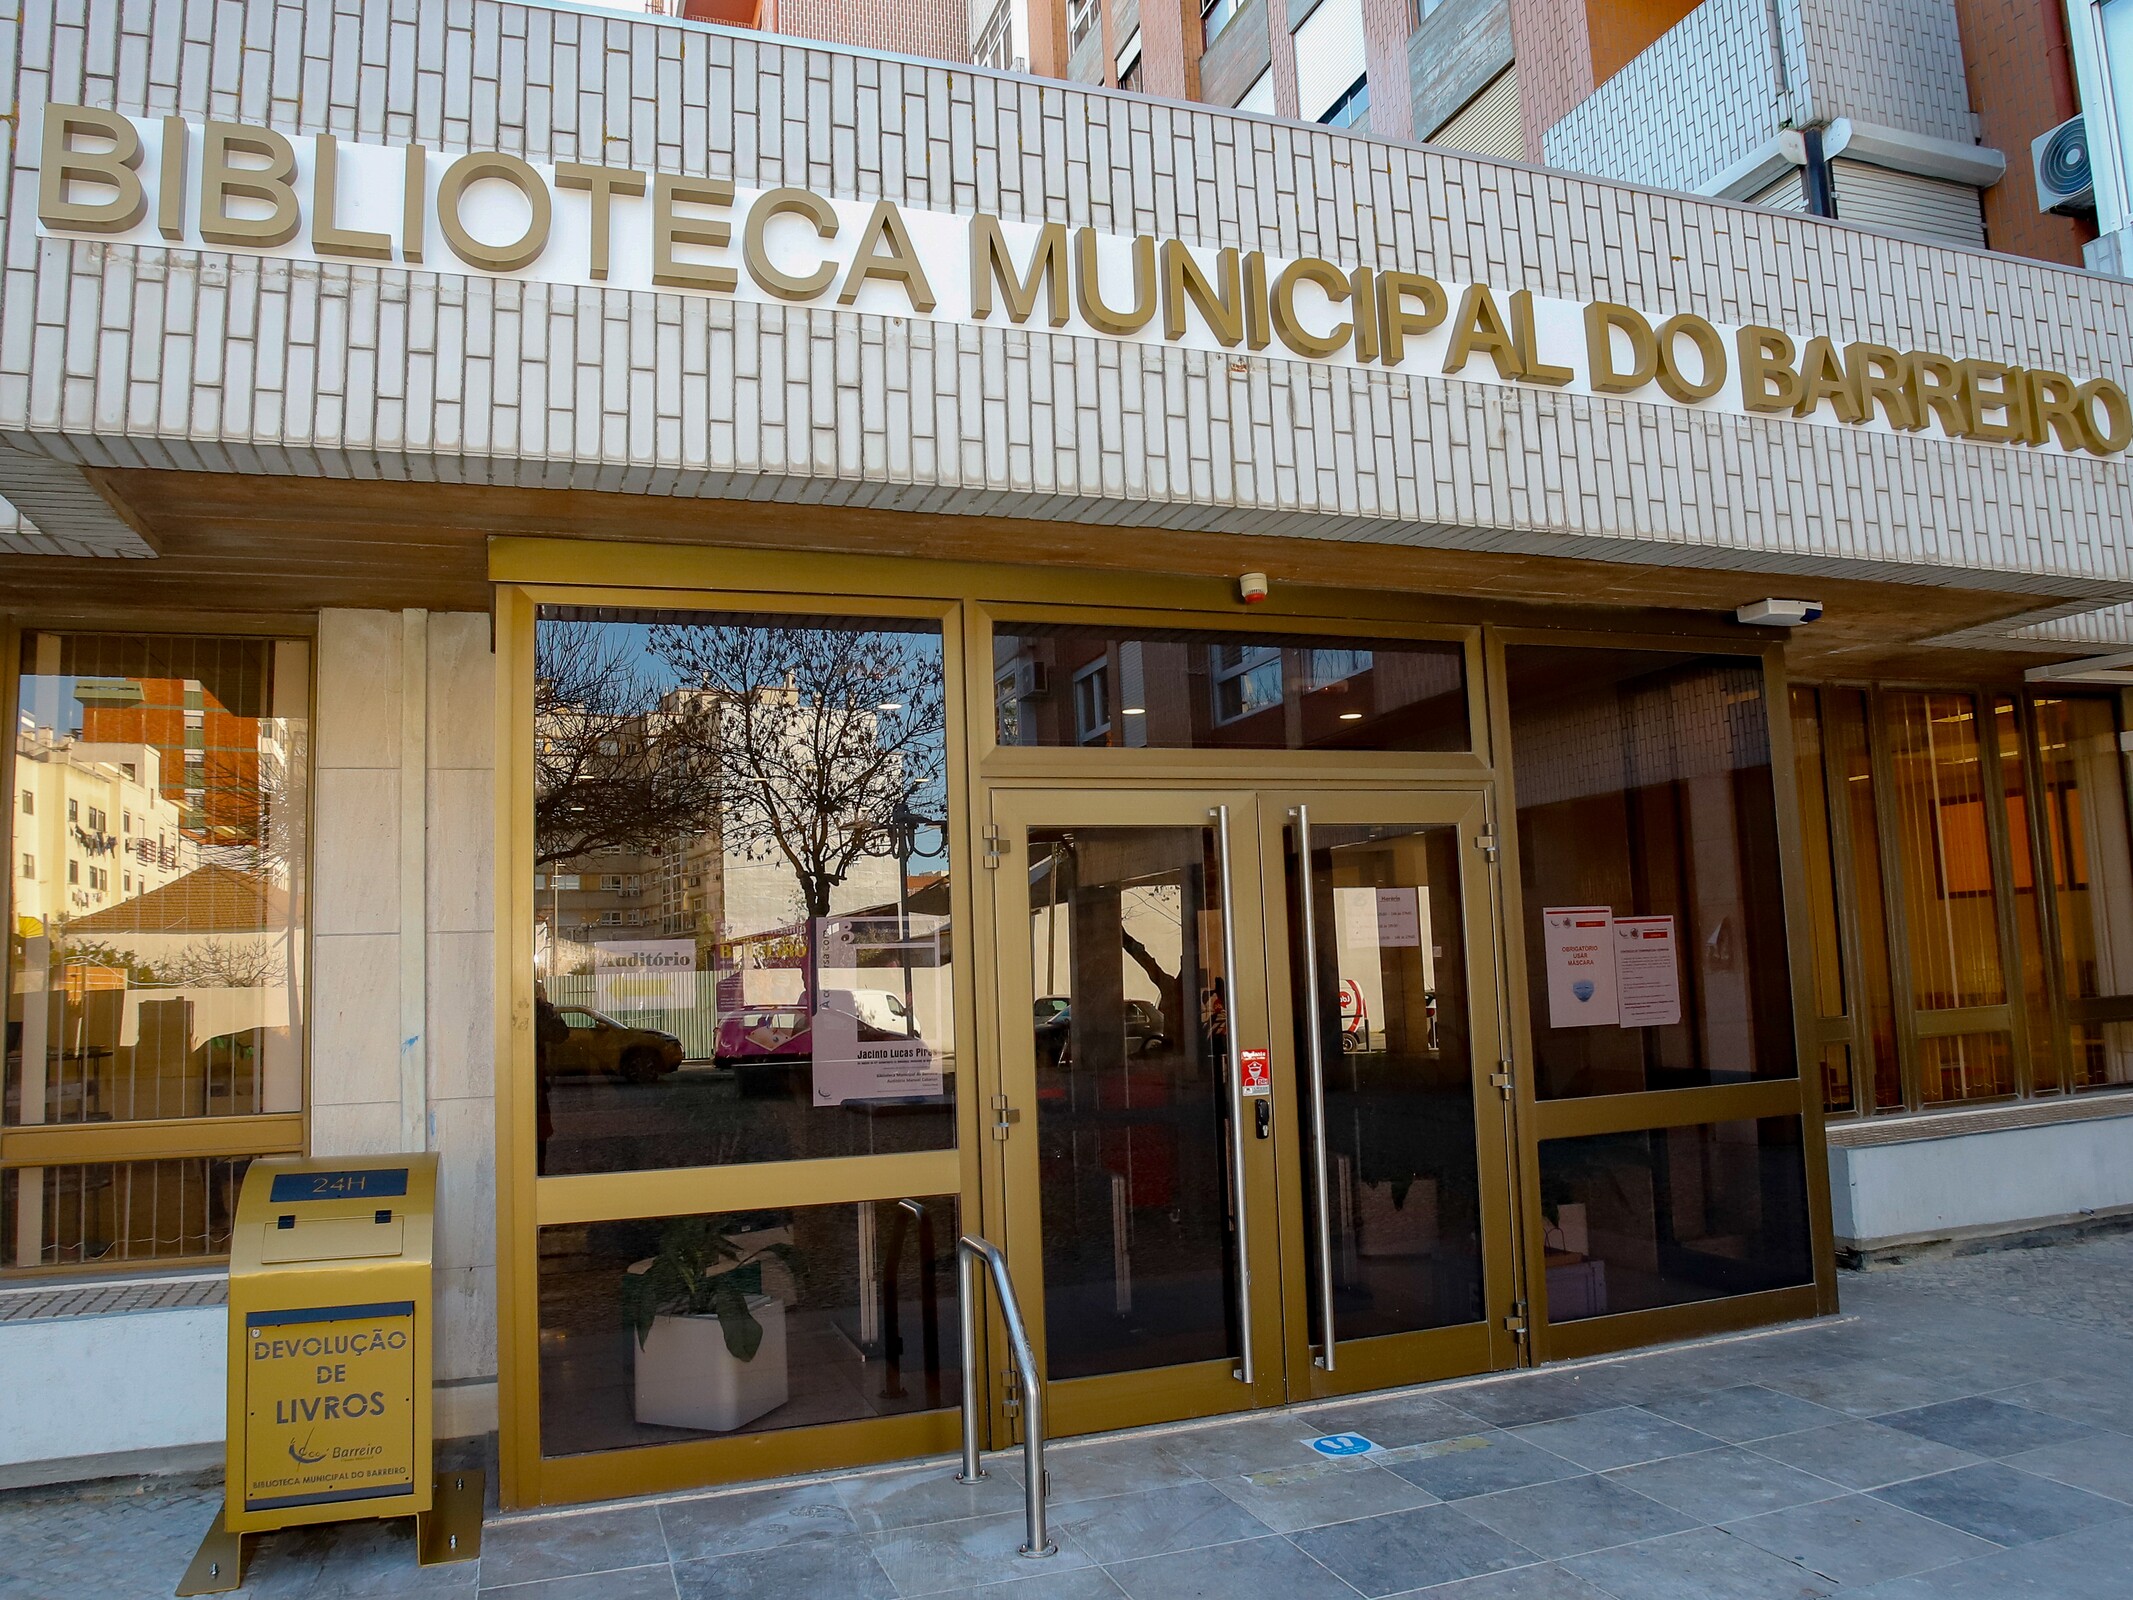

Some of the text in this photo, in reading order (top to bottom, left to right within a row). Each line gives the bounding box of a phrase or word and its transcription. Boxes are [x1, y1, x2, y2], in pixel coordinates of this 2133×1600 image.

[37, 103, 2133, 457] BIBLIOTECA MUNICIPAL DO BARREIRO
[600, 952, 691, 968] Auditório
[857, 1049, 888, 1059] Jacinto
[890, 1048, 914, 1059] Lucas
[312, 1176, 366, 1193] 24H
[254, 1329, 407, 1360] DEVOLUÇÃO
[316, 1364, 346, 1384] DE
[276, 1391, 385, 1424] LIVROS
[332, 1443, 383, 1459] Barreiro
[253, 1466, 407, 1489] BIBLIOTECA MUNICIPAL DO BARREIRO
